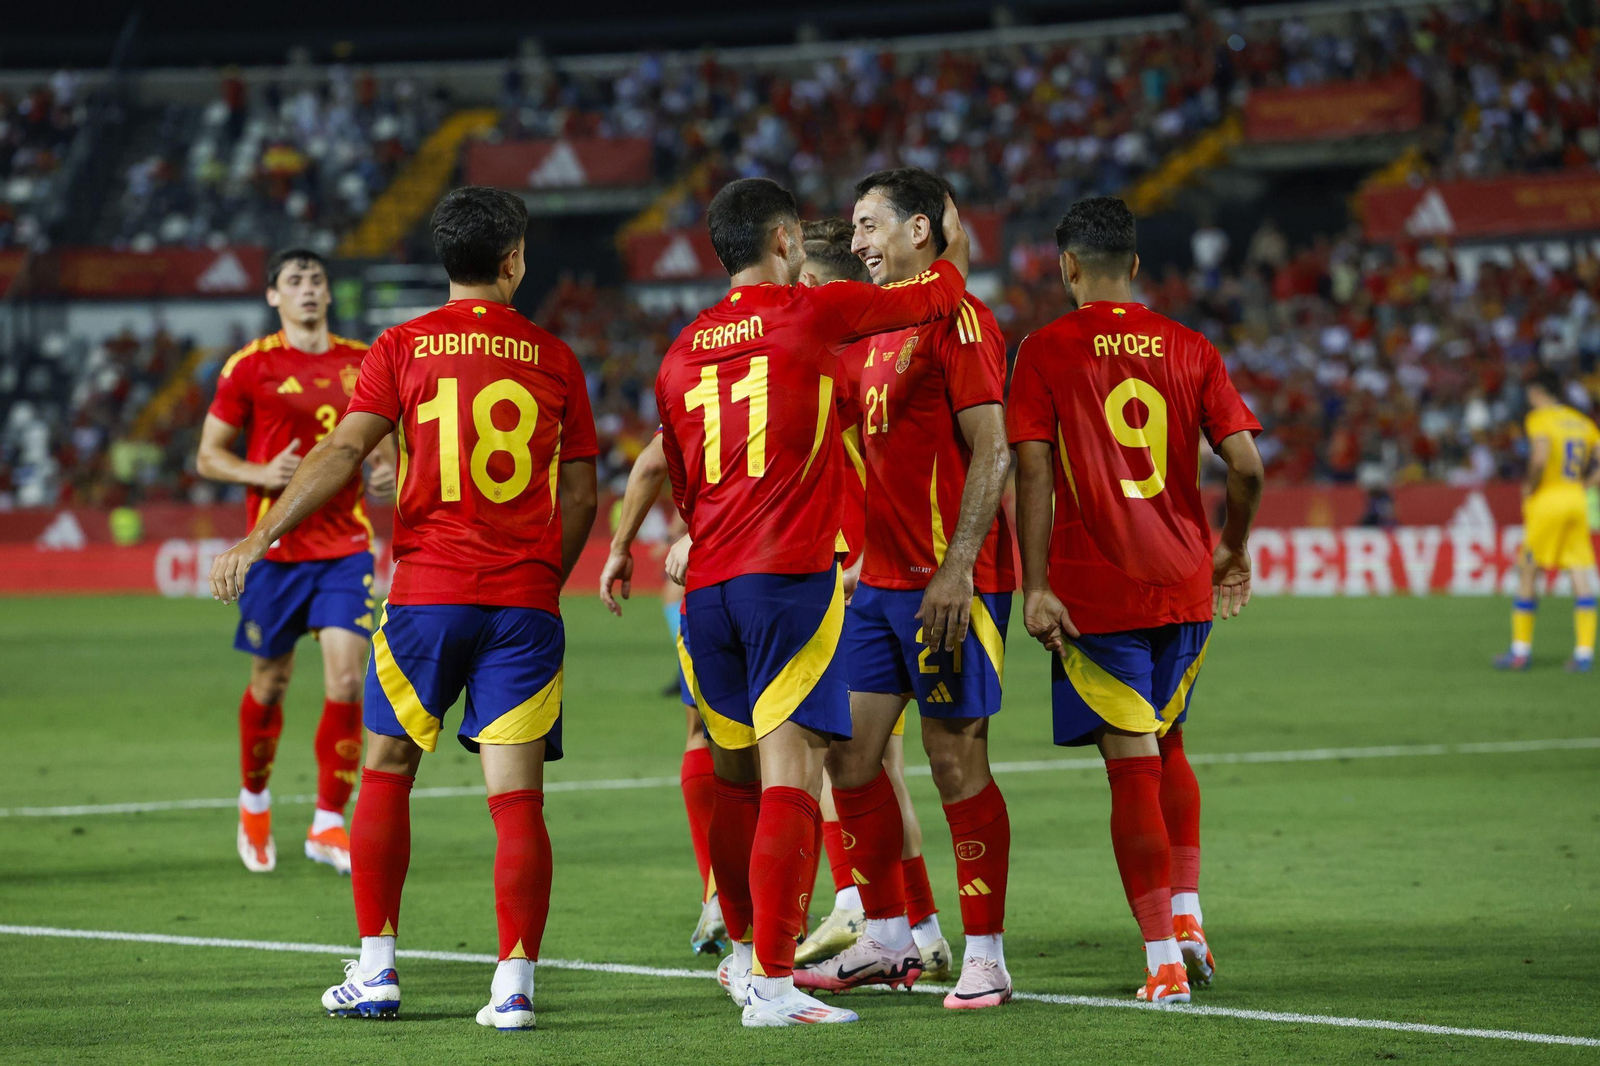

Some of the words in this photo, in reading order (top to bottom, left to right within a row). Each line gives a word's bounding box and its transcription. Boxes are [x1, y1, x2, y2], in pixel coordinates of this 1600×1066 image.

[414, 332, 539, 365] ZUBIMENDI
[691, 315, 764, 351] FERRAN
[1094, 333, 1164, 358] AYOZE
[315, 404, 338, 442] 3
[684, 355, 768, 485] 11
[865, 383, 889, 435] 21
[417, 377, 539, 504] 18
[1104, 377, 1168, 499] 9
[1249, 526, 1600, 596] CERVE
[915, 626, 962, 674] 21
